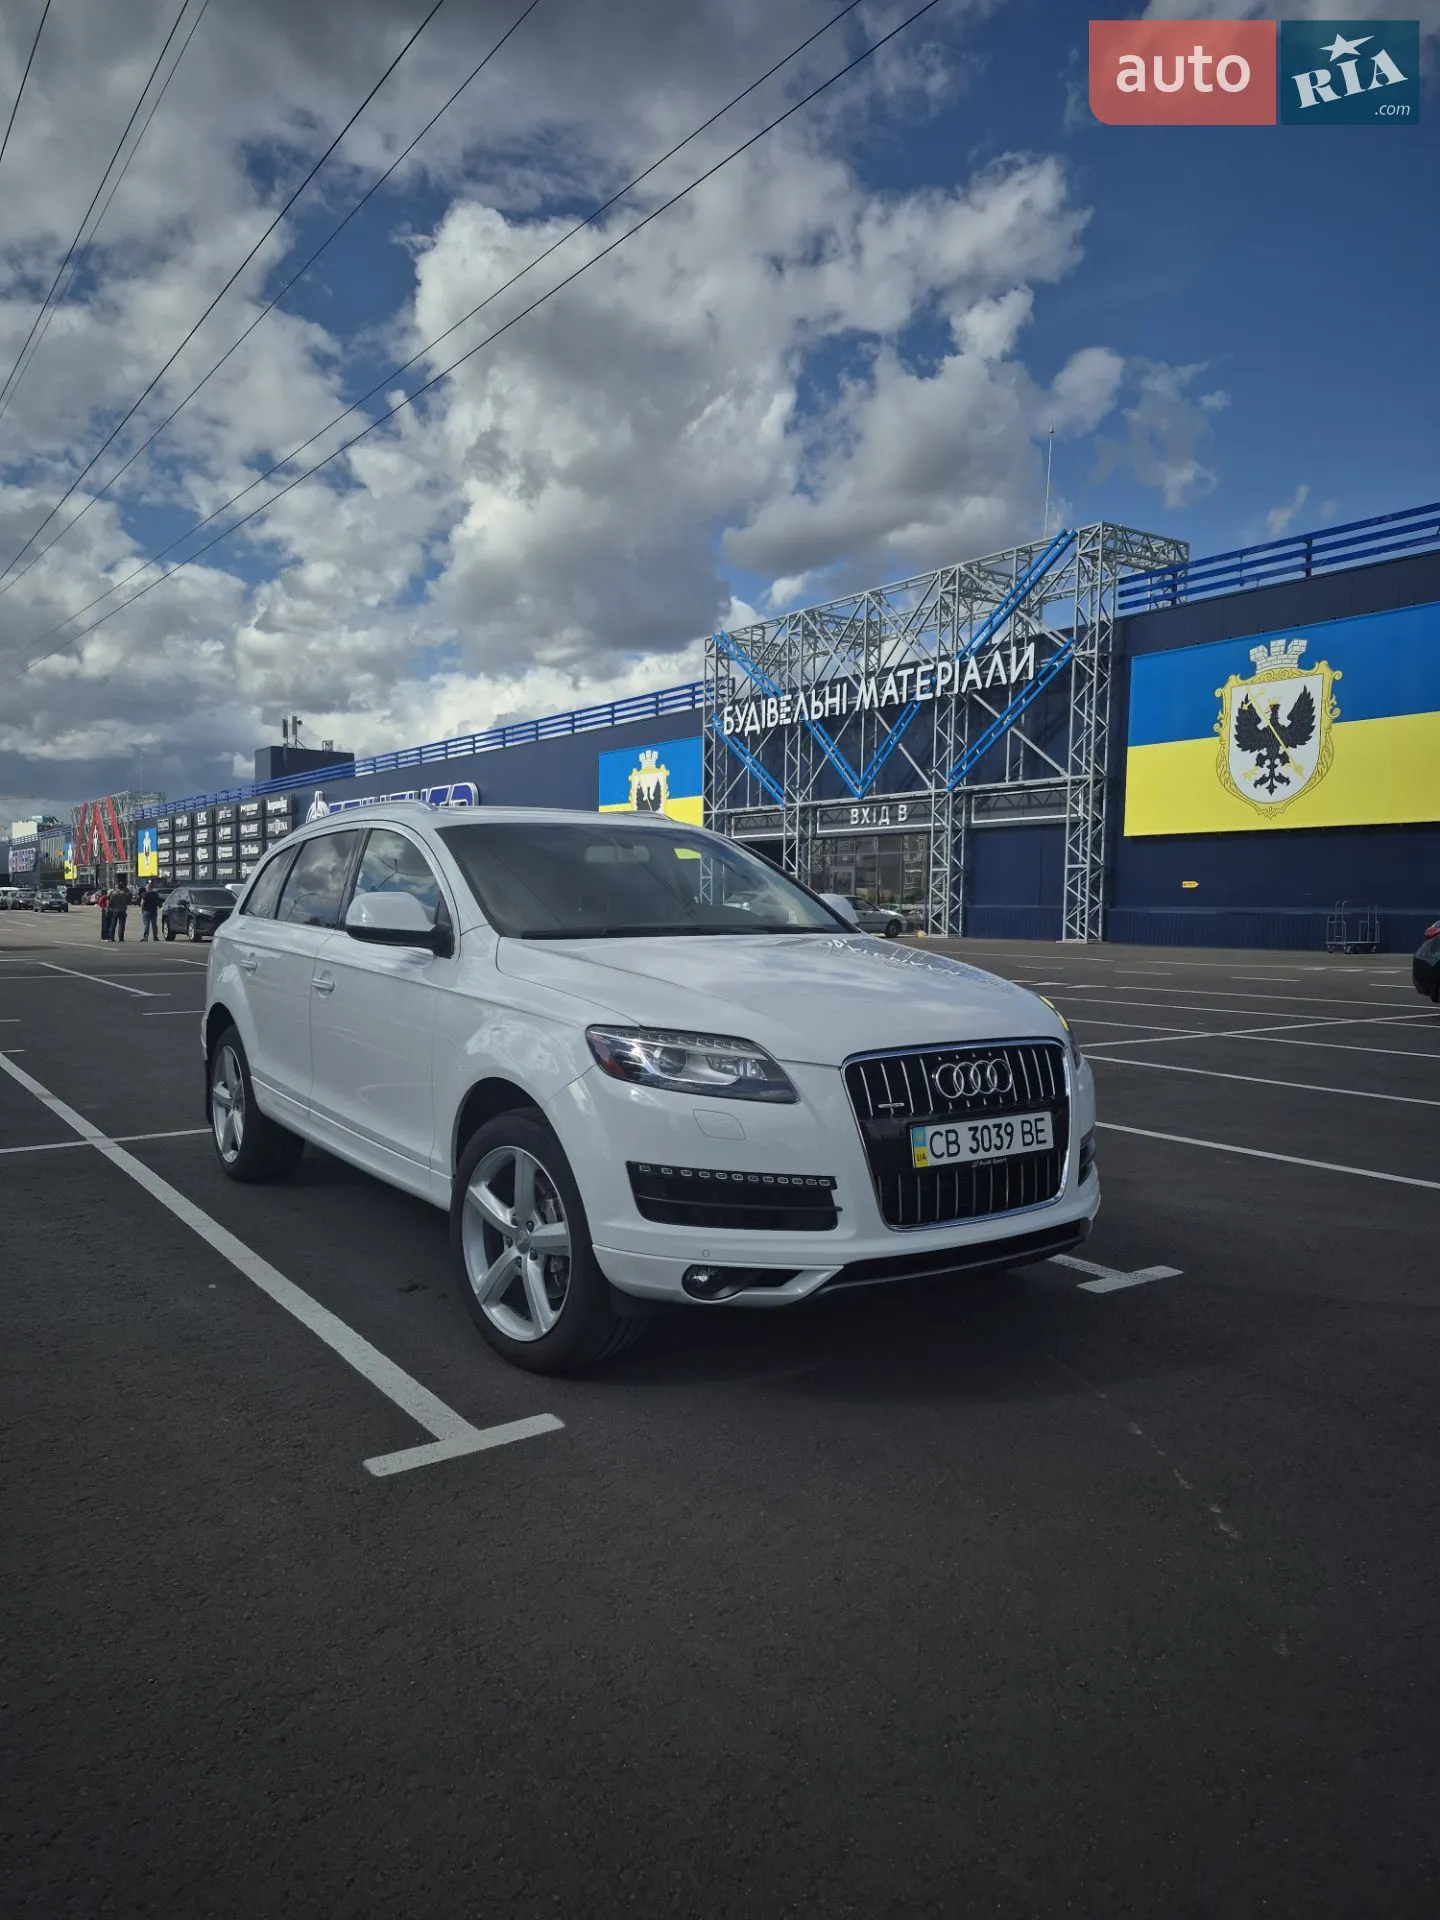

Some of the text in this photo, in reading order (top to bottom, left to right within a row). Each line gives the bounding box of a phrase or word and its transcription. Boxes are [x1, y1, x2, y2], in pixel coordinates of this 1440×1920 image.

[723, 642, 1036, 737] БУДІВЕЛЬНІ МАТЕРІАЛИ
[850, 805, 890, 825] ВХІД
[929, 1117, 1048, 1159] CB 3039 BE
[916, 1153, 927, 1162] UA
